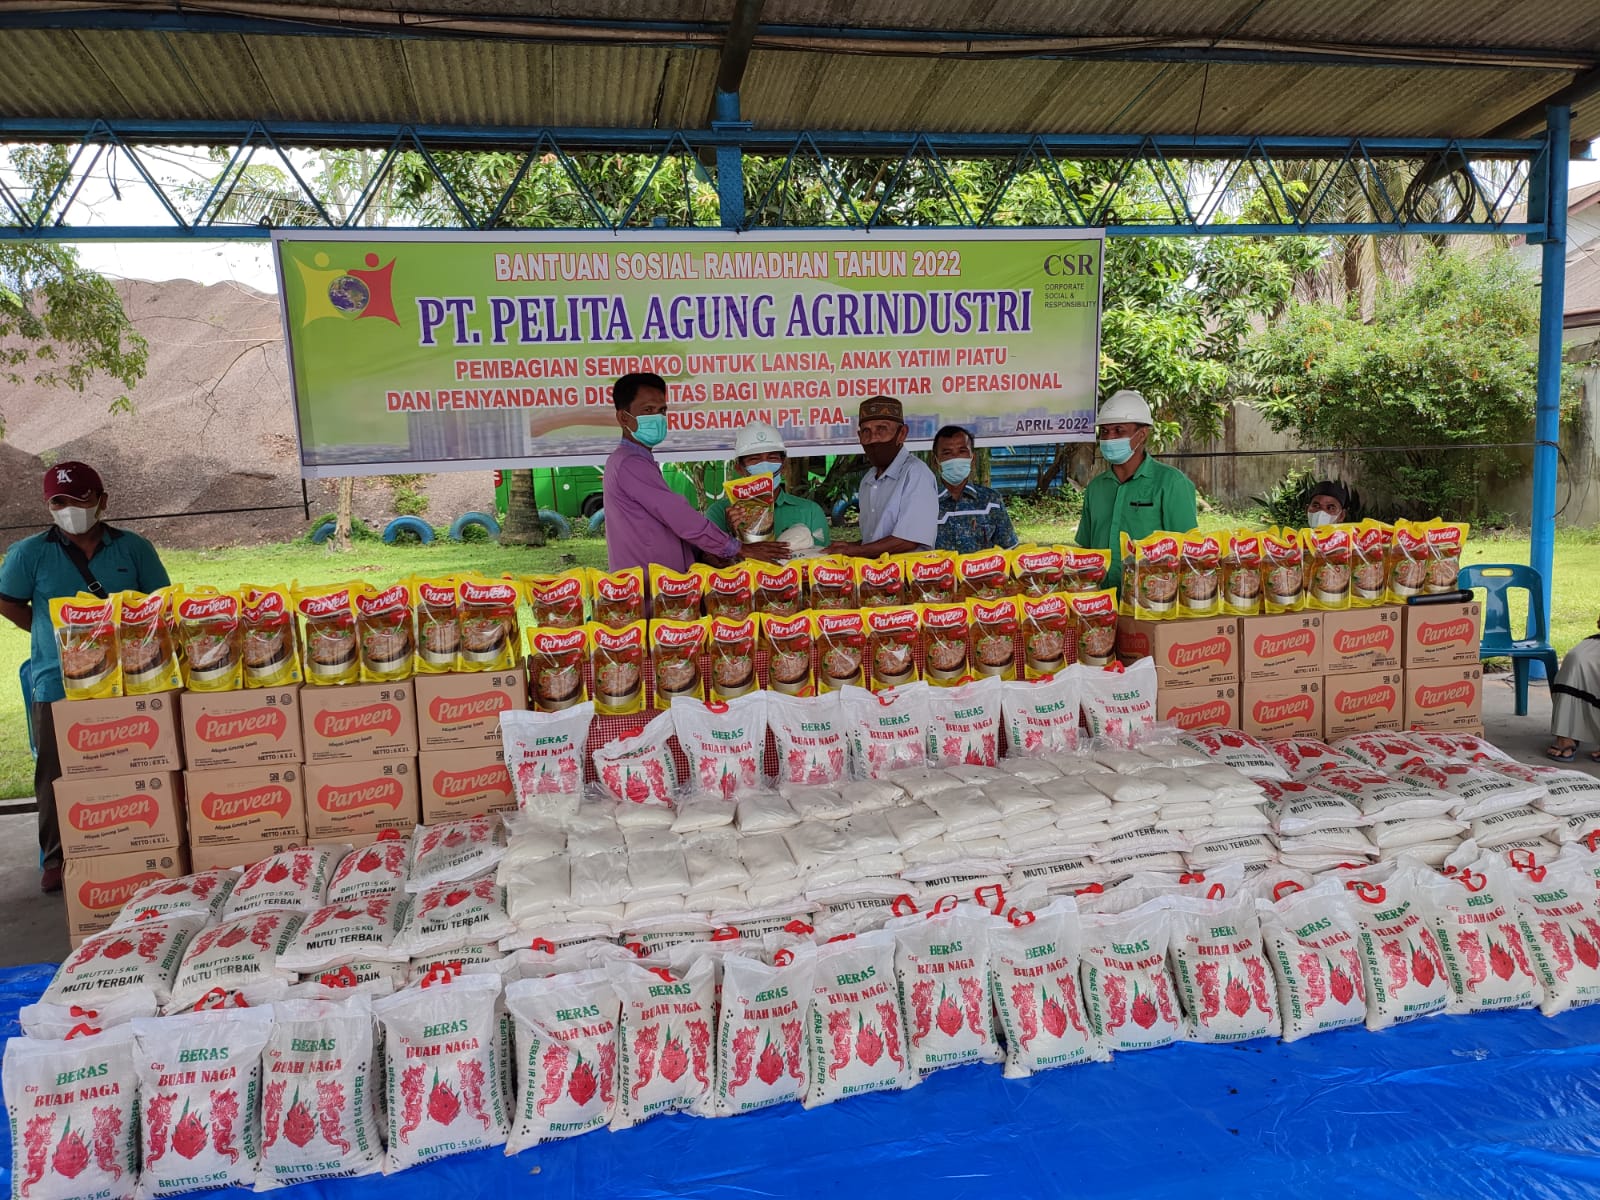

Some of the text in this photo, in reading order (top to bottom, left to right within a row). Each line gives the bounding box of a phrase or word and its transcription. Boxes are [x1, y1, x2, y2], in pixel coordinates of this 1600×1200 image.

[495, 251, 961, 281] BANTUAN SOSIAL RAMADHAN TAHUN 2022
[1044, 254, 1094, 276] CSR
[419, 290, 1031, 344] PT. PELITA AGUNG AGRINDUSTRI
[456, 348, 1007, 380] PEMBAGIAN SEMBAKO UNTUK LANSIA, ANAK YATIM PIATU
[388, 373, 1062, 411] DAN PENYANDANG DISITAS BAGI WARGA DISEKITAR OPERASIONAL
[668, 408, 849, 430] RUSAHAAN PT. PAA.
[1016, 417, 1088, 432] APRIL 2022
[57, 469, 72, 484] K
[966, 556, 1001, 572] Parveen
[714, 575, 745, 589] Parveen
[761, 572, 793, 586] Parveen
[866, 567, 896, 582] Parveen
[663, 577, 697, 591] Parveen
[187, 598, 231, 616] Parveen
[1078, 597, 1109, 611] Parveen
[824, 617, 860, 628] Parveen
[875, 614, 913, 627] Parveen
[929, 610, 963, 623] Parveen
[770, 619, 805, 634] Parveen
[1423, 622, 1468, 643] Parveen
[600, 630, 637, 647] Parveen
[1260, 632, 1310, 657] Parveen
[1340, 628, 1389, 650] Parveen
[1175, 641, 1226, 664] Parveen
[1112, 690, 1140, 701] BERAS
[1341, 689, 1390, 711] Parveen
[1422, 683, 1470, 705] Parveen
[438, 695, 504, 721] Parveen
[954, 706, 984, 719] BERAS
[1035, 700, 1065, 714] BERAS
[1105, 701, 1151, 714] BUAH NAGA
[1259, 698, 1308, 721] Parveen
[206, 712, 278, 739] Parveen
[324, 707, 392, 735] Parveen
[801, 722, 831, 731] BERAS
[879, 714, 910, 726] BERAS
[945, 718, 993, 732] BUAH NAGA
[1027, 712, 1073, 727] BUAH NAGA
[78, 721, 150, 749] Parveen
[536, 734, 568, 746] BERAS
[712, 728, 744, 740] BERAS
[791, 733, 840, 746] BUAH NAGA
[870, 726, 919, 740] BUAH NAGA
[523, 749, 547, 758] BUAH
[702, 741, 753, 753] BUAH NAGA
[441, 769, 507, 794] Parveen
[212, 789, 283, 818] Parveen
[326, 781, 395, 810] Parveen
[79, 799, 150, 829] Parveen
[1290, 799, 1346, 814] MUTU TERBAIK
[1482, 808, 1536, 826] MUTU TERBAIK
[261, 830, 279, 838] NETTO
[1205, 838, 1262, 853] MUTU TERBAIK
[1023, 861, 1085, 879] MUTU TERBAIK
[1532, 889, 1569, 903] BERAS
[234, 897, 302, 913] MUTU TERBAIK
[829, 898, 894, 913] MUTU TERBAIK
[1374, 901, 1411, 922] BERAS
[421, 913, 490, 935] MUTU TERBAIK
[1295, 917, 1332, 938] BERAS
[306, 934, 383, 951] MUTU TERBAIK
[930, 941, 963, 955] BERAS
[1112, 939, 1150, 955] BERAS
[917, 958, 975, 974] BUAH NAGA
[1103, 954, 1163, 971] BUAH NAGA
[182, 963, 261, 987] MUTU TERBAIK
[836, 966, 876, 986] BERAS
[1014, 966, 1043, 977] BUAH
[61, 974, 144, 994] MUTU TERBAIK
[648, 983, 691, 997] BERAS
[828, 982, 888, 1005] BUAH NAGA
[557, 1005, 599, 1022] BERAS
[641, 1002, 702, 1020] BUAH NAGA
[744, 1000, 798, 1020] BUAH NAGA
[423, 1020, 468, 1038] BERAS
[583, 1021, 614, 1038] NAGA
[291, 1039, 336, 1051] BERAS
[406, 1038, 479, 1059] BUAH NAGA
[529, 1039, 540, 1066] BERAS
[179, 1048, 229, 1063] BERAS
[56, 1063, 108, 1086] BERAS
[271, 1059, 342, 1074] BUAH NAGA
[158, 1066, 237, 1087] BUAH NAGA
[34, 1083, 120, 1107] BUAH NAGA
[525, 1090, 535, 1120] SUPER
[275, 1160, 341, 1174] BRUTTO KG
[158, 1171, 227, 1187] BRUTTO KG
